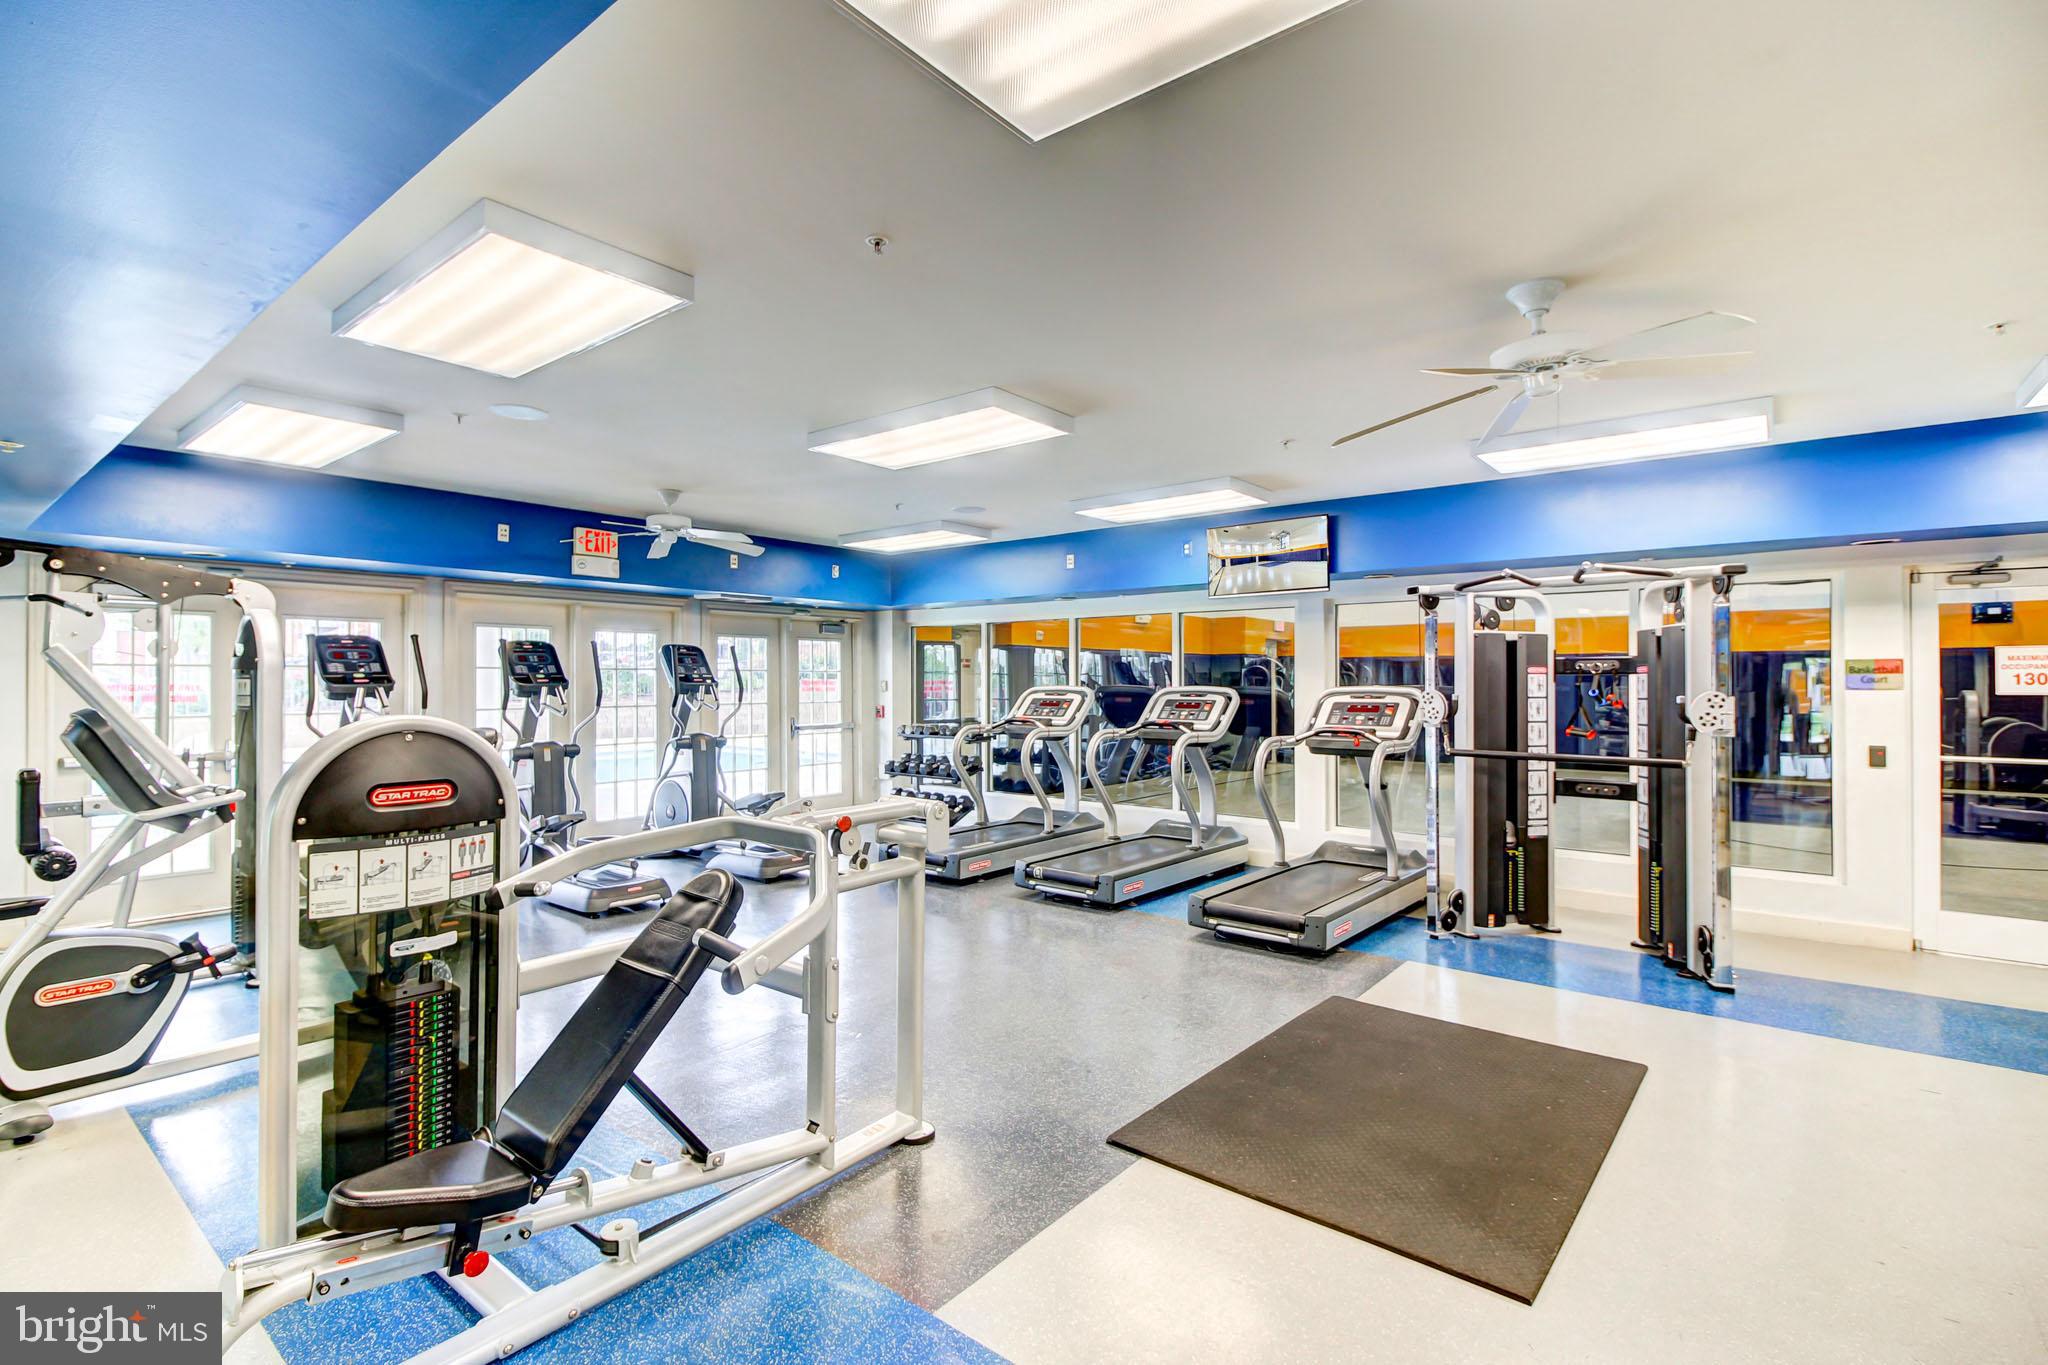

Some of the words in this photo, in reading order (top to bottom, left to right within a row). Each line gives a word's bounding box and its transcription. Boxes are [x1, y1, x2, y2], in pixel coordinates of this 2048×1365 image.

[585, 529, 612, 554] EXIT
[1848, 665, 1901, 674] Basketball
[1860, 675, 1888, 684] Court
[2012, 672, 2048, 686] 130
[378, 791, 411, 800] STAR
[412, 788, 446, 797] TRAC
[385, 833, 446, 846] MULTI-PRESS
[45, 988, 77, 998] STAR
[78, 982, 111, 993] TRAC
